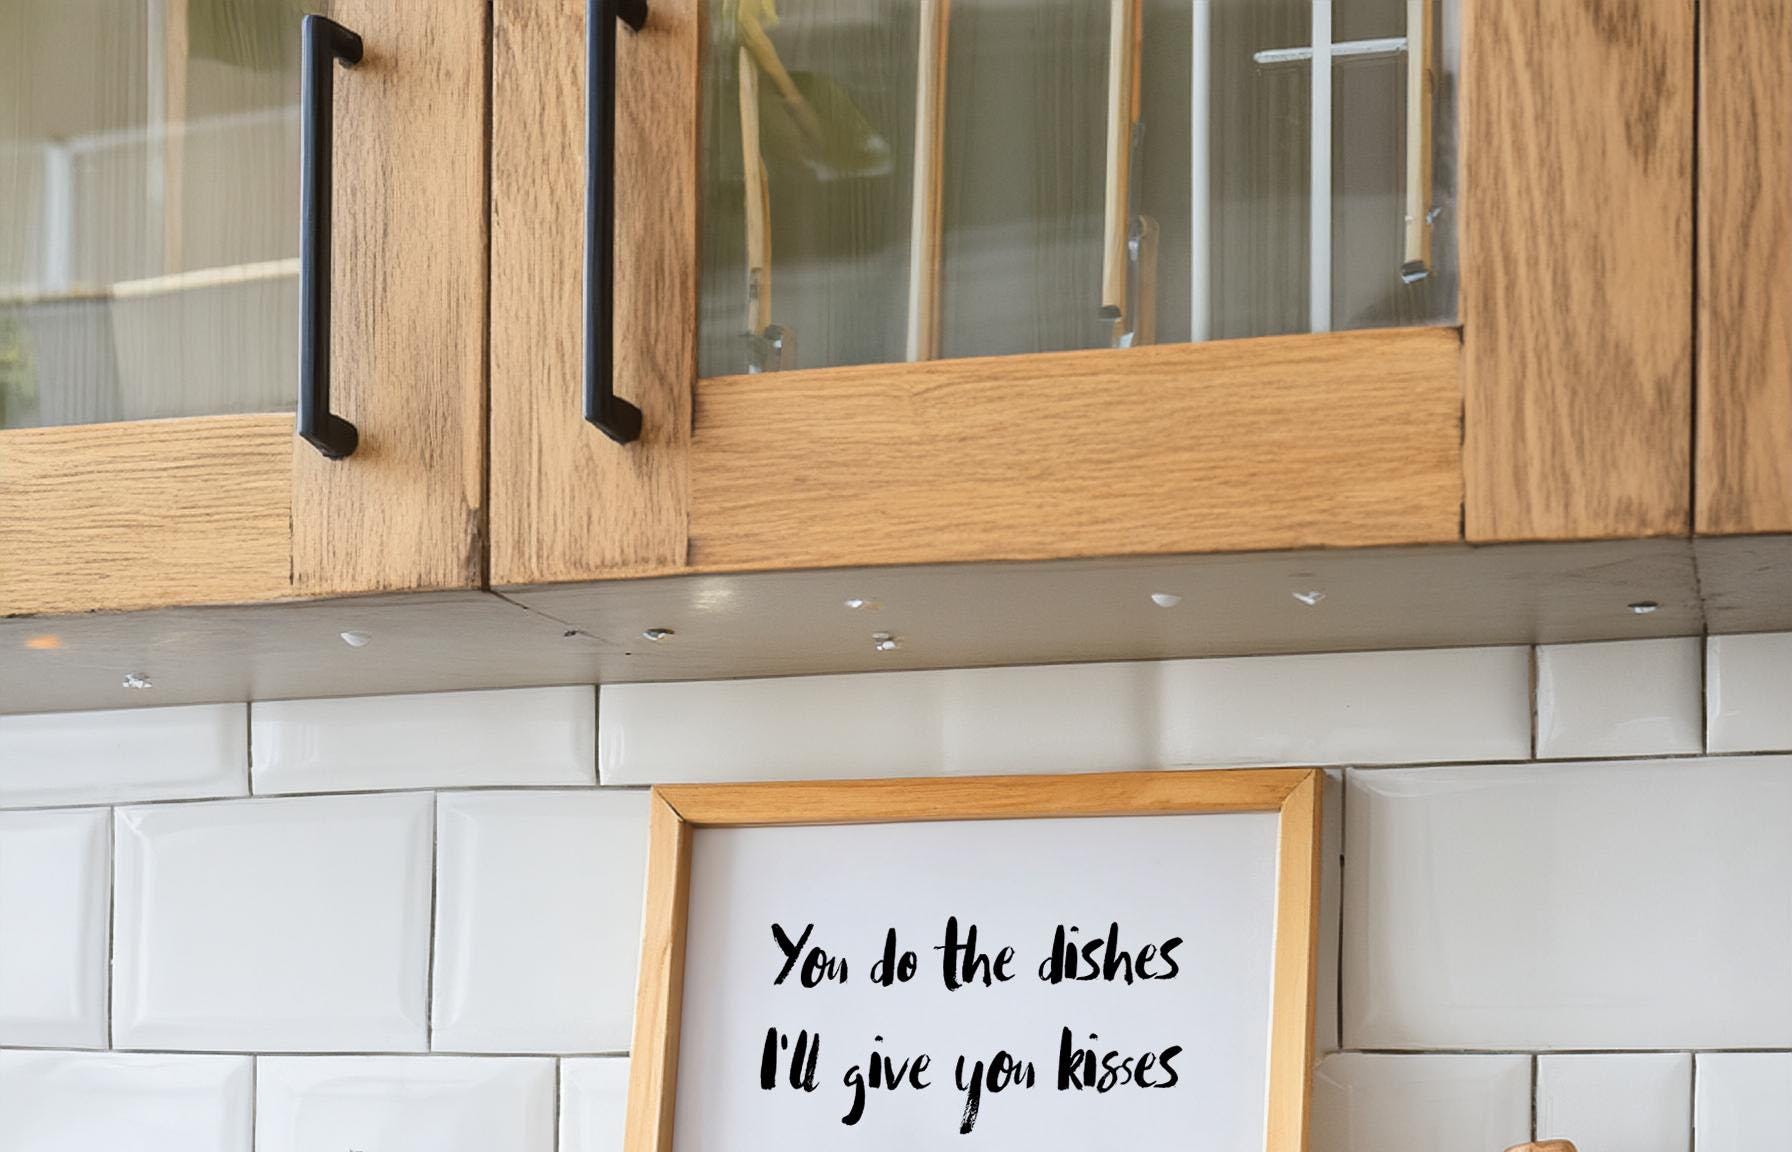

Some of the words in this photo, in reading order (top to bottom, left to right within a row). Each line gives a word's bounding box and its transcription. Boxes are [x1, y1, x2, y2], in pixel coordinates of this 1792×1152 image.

[771, 924, 848, 988] You
[870, 928, 917, 987] do
[933, 916, 1015, 992] the
[1038, 922, 1183, 985] dishes
[760, 1027, 820, 1092] I'll
[841, 1035, 931, 1126] give
[955, 1051, 1035, 1134] you
[1057, 1027, 1183, 1093] kisses
